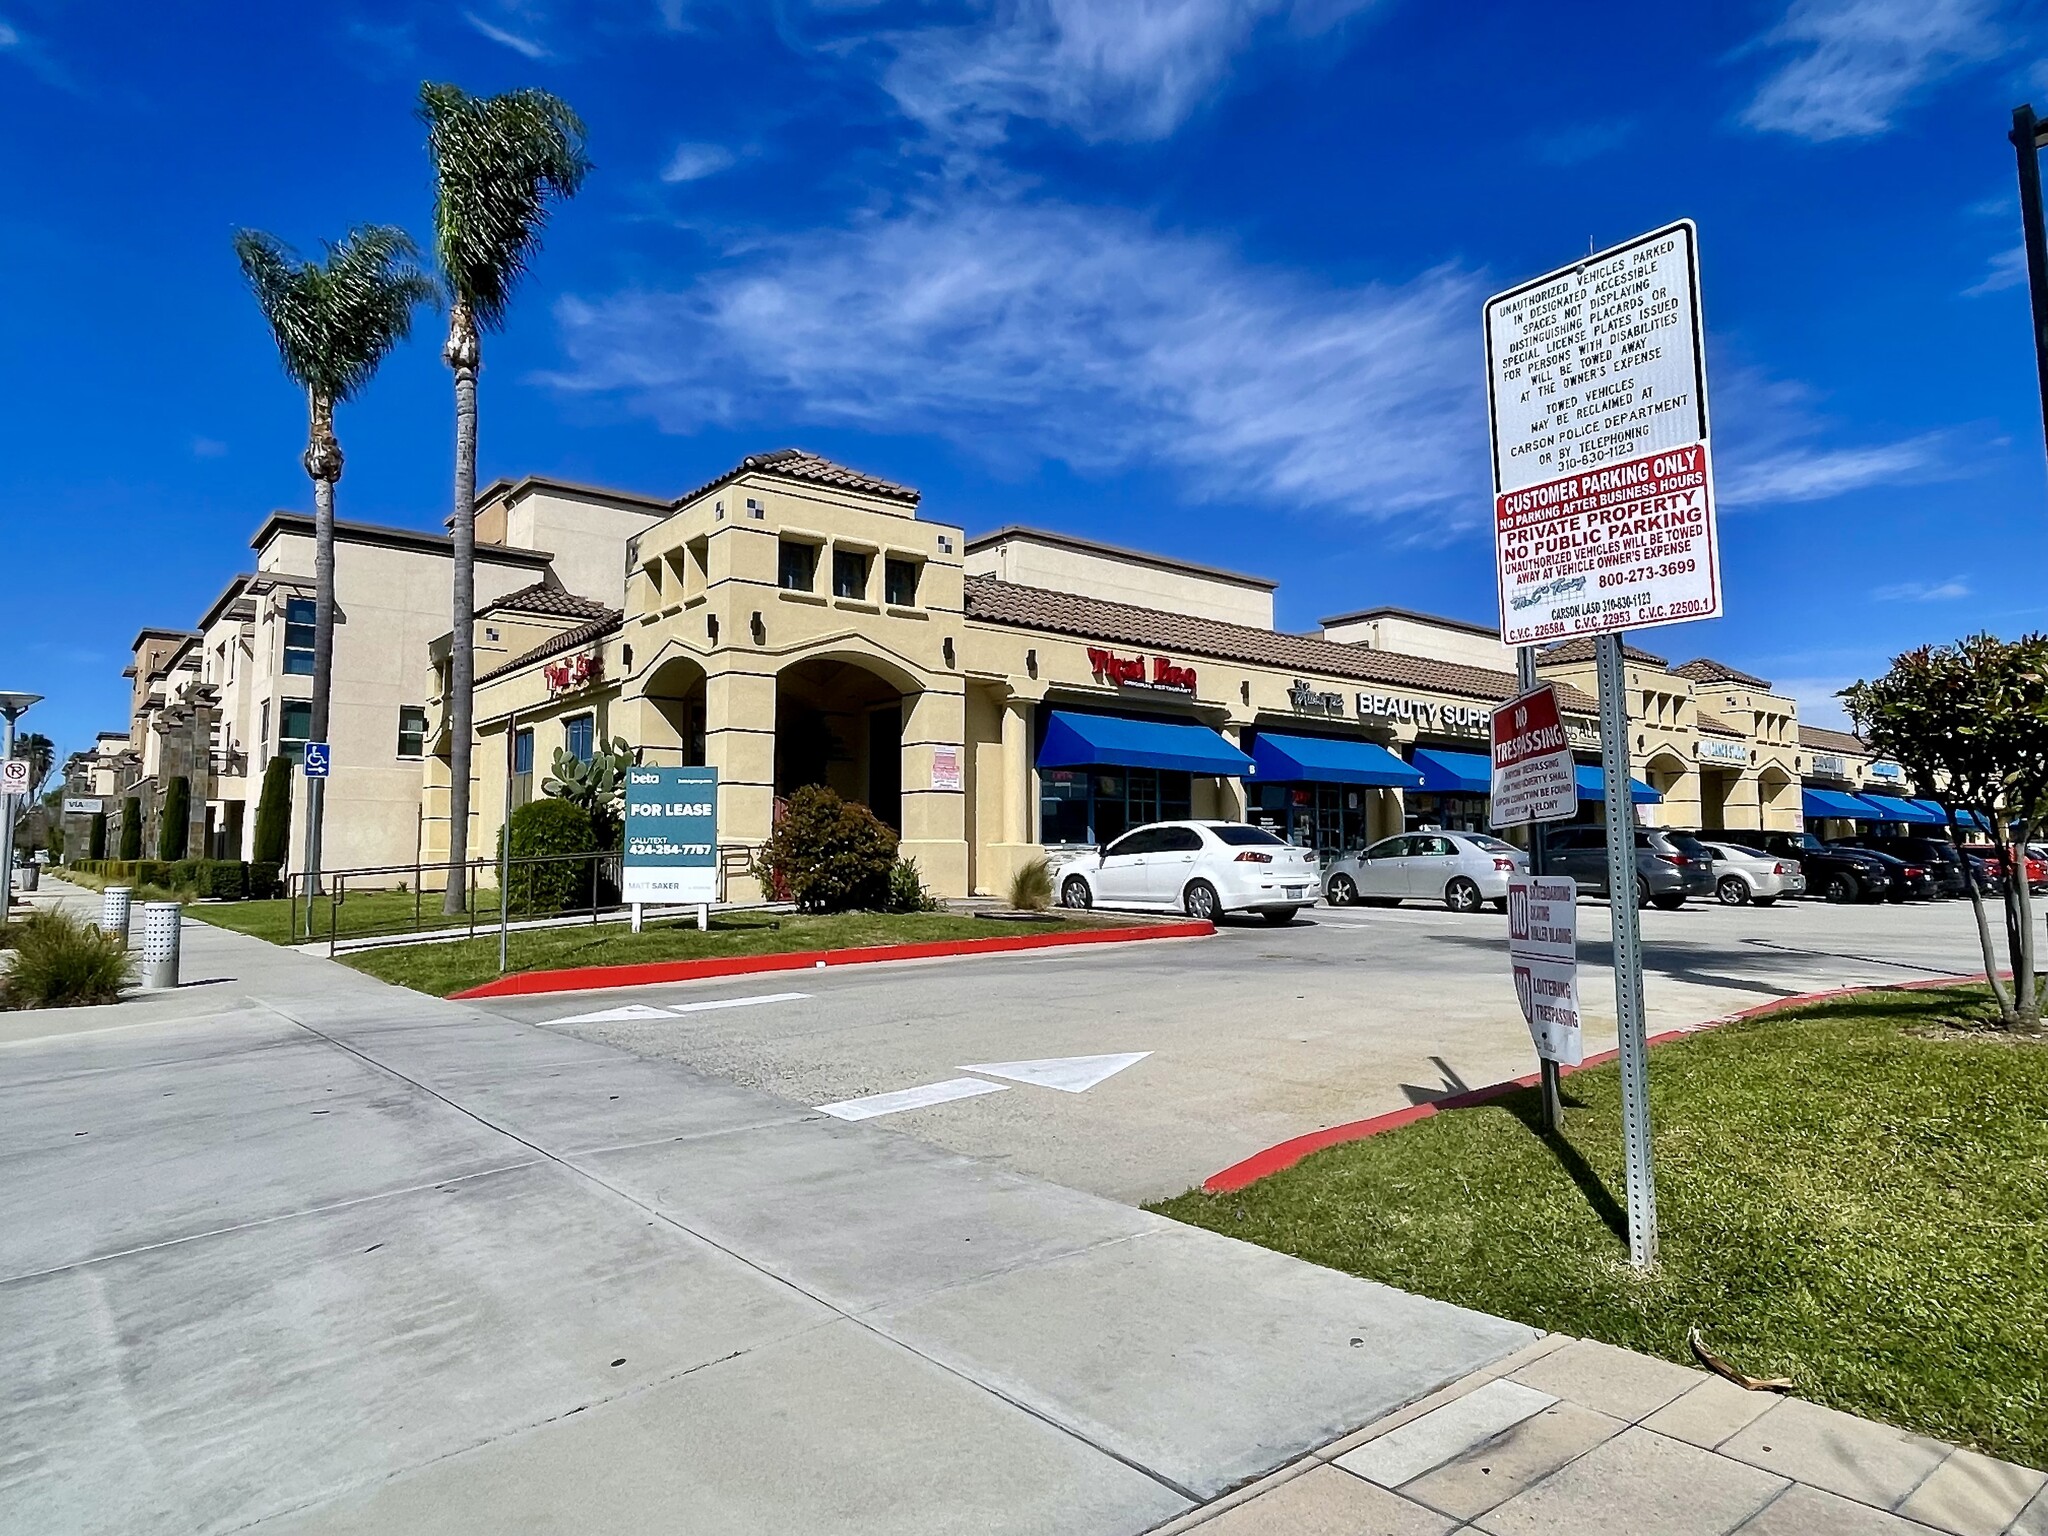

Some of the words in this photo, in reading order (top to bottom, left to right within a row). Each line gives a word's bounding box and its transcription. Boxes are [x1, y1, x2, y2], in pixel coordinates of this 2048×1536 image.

[1500, 282, 1569, 317] UNAUTHORIZED
[1577, 260, 1625, 286] VEHICLES
[1633, 241, 1674, 264] PARKED
[1514, 314, 1523, 325] IN
[1530, 289, 1587, 318] DESIGNATED
[1595, 261, 1658, 293] ACCESSIBLE
[1510, 319, 1582, 353] DISTINGUISHING
[1590, 297, 1644, 323] PLACARDS
[1652, 287, 1666, 300] OR
[1523, 314, 1557, 335] SPACES
[1564, 304, 1582, 318] NOT
[1590, 279, 1650, 310] DISPLAYING
[1503, 348, 1539, 369] SPECIAL
[1547, 332, 1586, 353] LICENSE
[1594, 315, 1632, 336] PLATES
[1640, 298, 1678, 320] ISSUED
[1504, 367, 1521, 381] FOR
[1528, 351, 1570, 372] PERSONS
[1579, 340, 1602, 356] WITH
[1610, 313, 1678, 345] DISABILITIES
[1521, 391, 1530, 403] AT
[1538, 384, 1556, 398] THE
[1564, 367, 1606, 388] OWNER'S
[1614, 348, 1661, 371] EXPENSE
[1531, 372, 1552, 385] WILL
[1560, 363, 1572, 376] BE
[1581, 350, 1612, 369] TOWED
[1621, 337, 1647, 355] AWAY
[1531, 419, 1549, 433] MAY
[1557, 411, 1569, 424] BE
[1577, 394, 1632, 418] RECLAIMED
[1642, 387, 1653, 399] AT
[1546, 396, 1577, 414] TOWED
[1585, 379, 1634, 400] VEHICLES
[1511, 434, 1554, 457] CARSON
[1560, 422, 1598, 442] POLICE
[1605, 395, 1688, 429] DEPARTMENT
[1539, 452, 1551, 465] OR
[1559, 446, 1571, 458] BY
[1579, 425, 1649, 454] TELEPHONING
[1559, 442, 1634, 472] 310-830-1123
[1500, 517, 1513, 530] NO
[1516, 504, 1560, 526] PARKING
[1563, 497, 1597, 516] AFTER
[1601, 482, 1656, 504] BUSINESS
[1660, 472, 1703, 492] HOURS
[1505, 480, 1578, 515] CUSTOMER
[1582, 463, 1648, 500] PARKING
[1654, 450, 1697, 479] ONLY
[1505, 546, 1528, 561] NO
[1535, 530, 1601, 555] PUBLIC
[1608, 507, 1701, 539] PARKING
[1507, 517, 1580, 546] PRIVATE
[1587, 491, 1696, 527] PROPERTY
[1505, 551, 1571, 575] UNAUTHORIZED
[1574, 541, 1620, 561] VEHICLES
[1624, 535, 1646, 549] WILL
[1650, 533, 1663, 544] BE
[1666, 525, 1703, 541] TOWED
[1517, 571, 1540, 585] AWAY
[1543, 568, 1552, 578] AT
[1556, 560, 1594, 577] VEHICLE
[1597, 551, 1640, 568] OWNER'S
[1644, 540, 1691, 559] EXPENSE
[1599, 559, 1695, 588] 800-273-3699
[1510, 628, 1532, 640] C.V.C.
[1535, 620, 1565, 635] 22658A
[1575, 616, 1600, 629] C.V.C.
[1603, 611, 1630, 624] 22953
[1639, 607, 1667, 620] C.V.C.
[1670, 600, 1708, 615] 22500.1
[1552, 604, 1581, 620] CARSON
[1582, 601, 1600, 615] LASD
[1602, 592, 1651, 612] 310-830-1123
[1360, 693, 1437, 721] BEAUTY
[1515, 706, 1527, 729] NO
[1496, 724, 1562, 762] TRESPASSING
[631, 772, 659, 783] beta
[1540, 788, 1549, 797] BE
[1551, 784, 1571, 795] FOUND
[1549, 771, 1568, 781] SHALL
[631, 804, 662, 816] FOR
[665, 804, 712, 816] LEASE
[1511, 891, 1526, 935] NO
[1533, 978, 1571, 999] LOITERING
[1536, 1004, 1578, 1028] TRESPASSING
